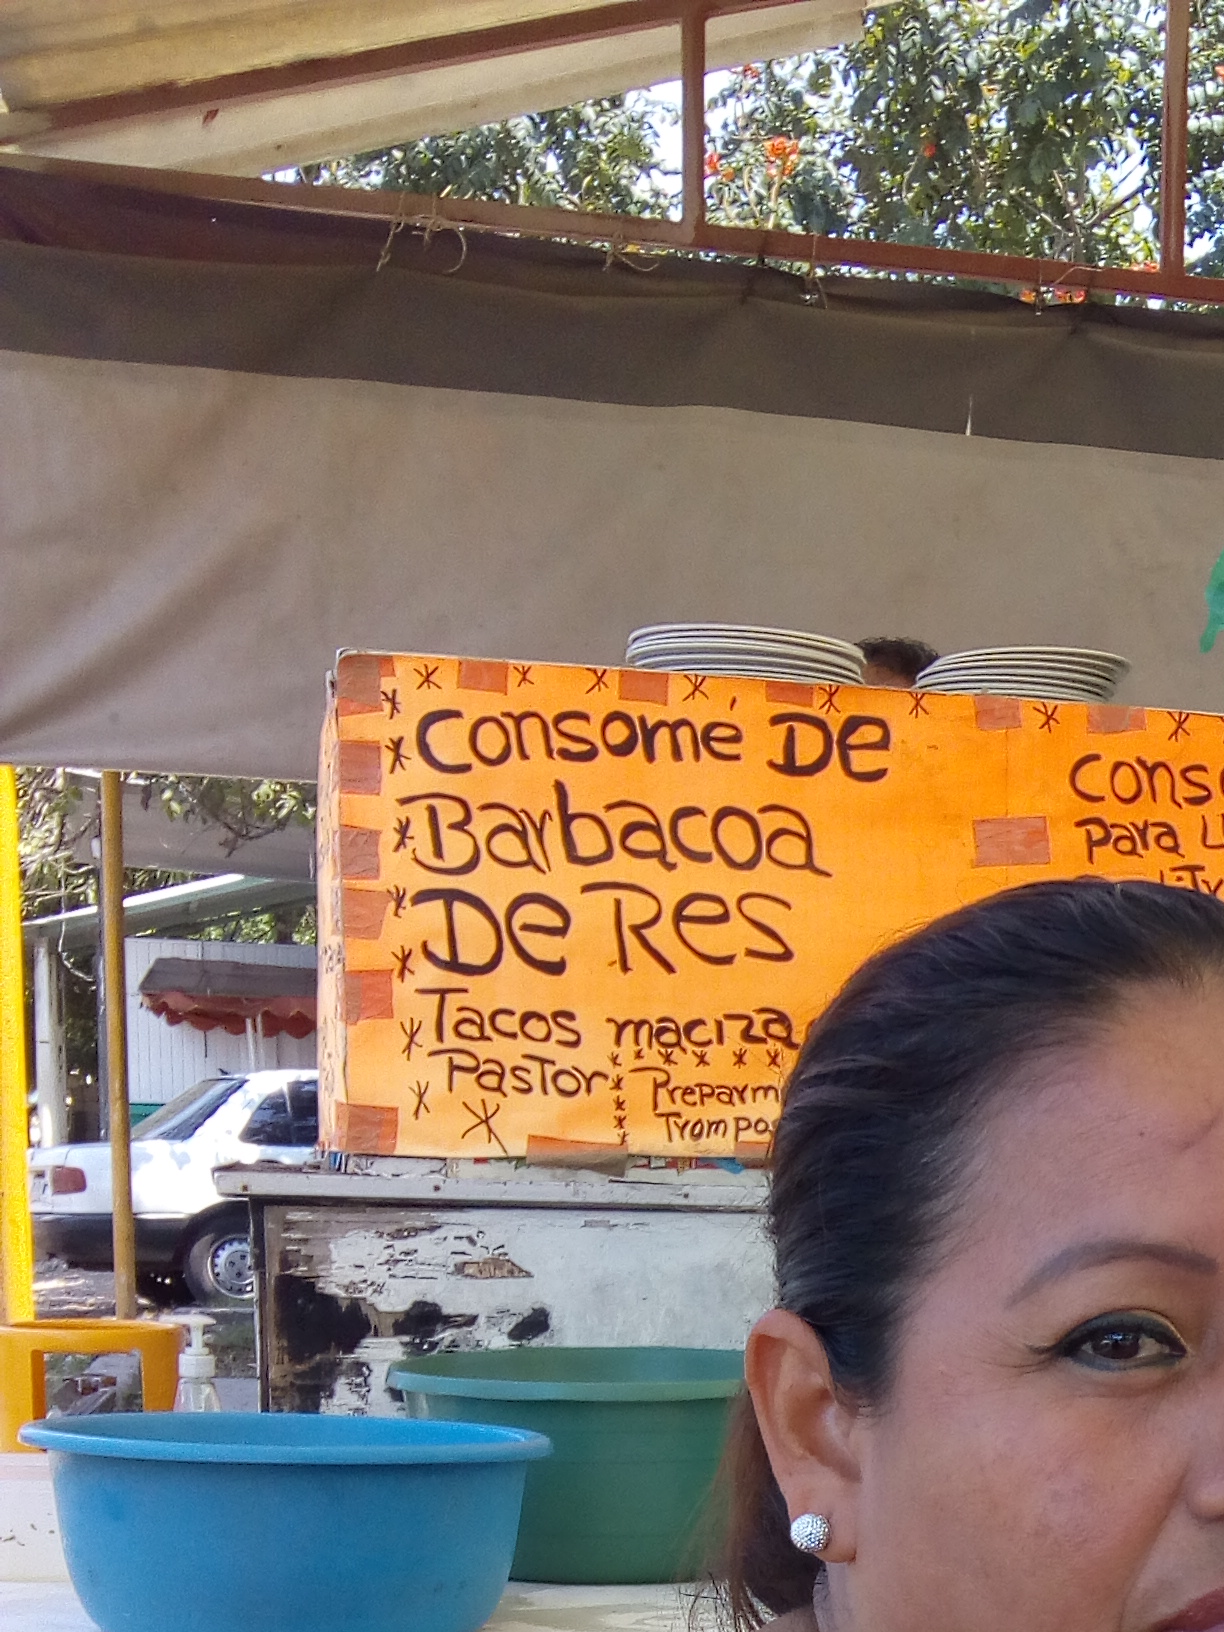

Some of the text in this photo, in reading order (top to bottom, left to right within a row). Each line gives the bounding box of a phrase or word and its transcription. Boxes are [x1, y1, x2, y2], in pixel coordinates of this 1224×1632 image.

[394, 779, 833, 877] Barbacoa
[1074, 817, 1185, 864] Para
[580, 881, 795, 975] Res
[415, 987, 800, 1054] Tacos maciza
